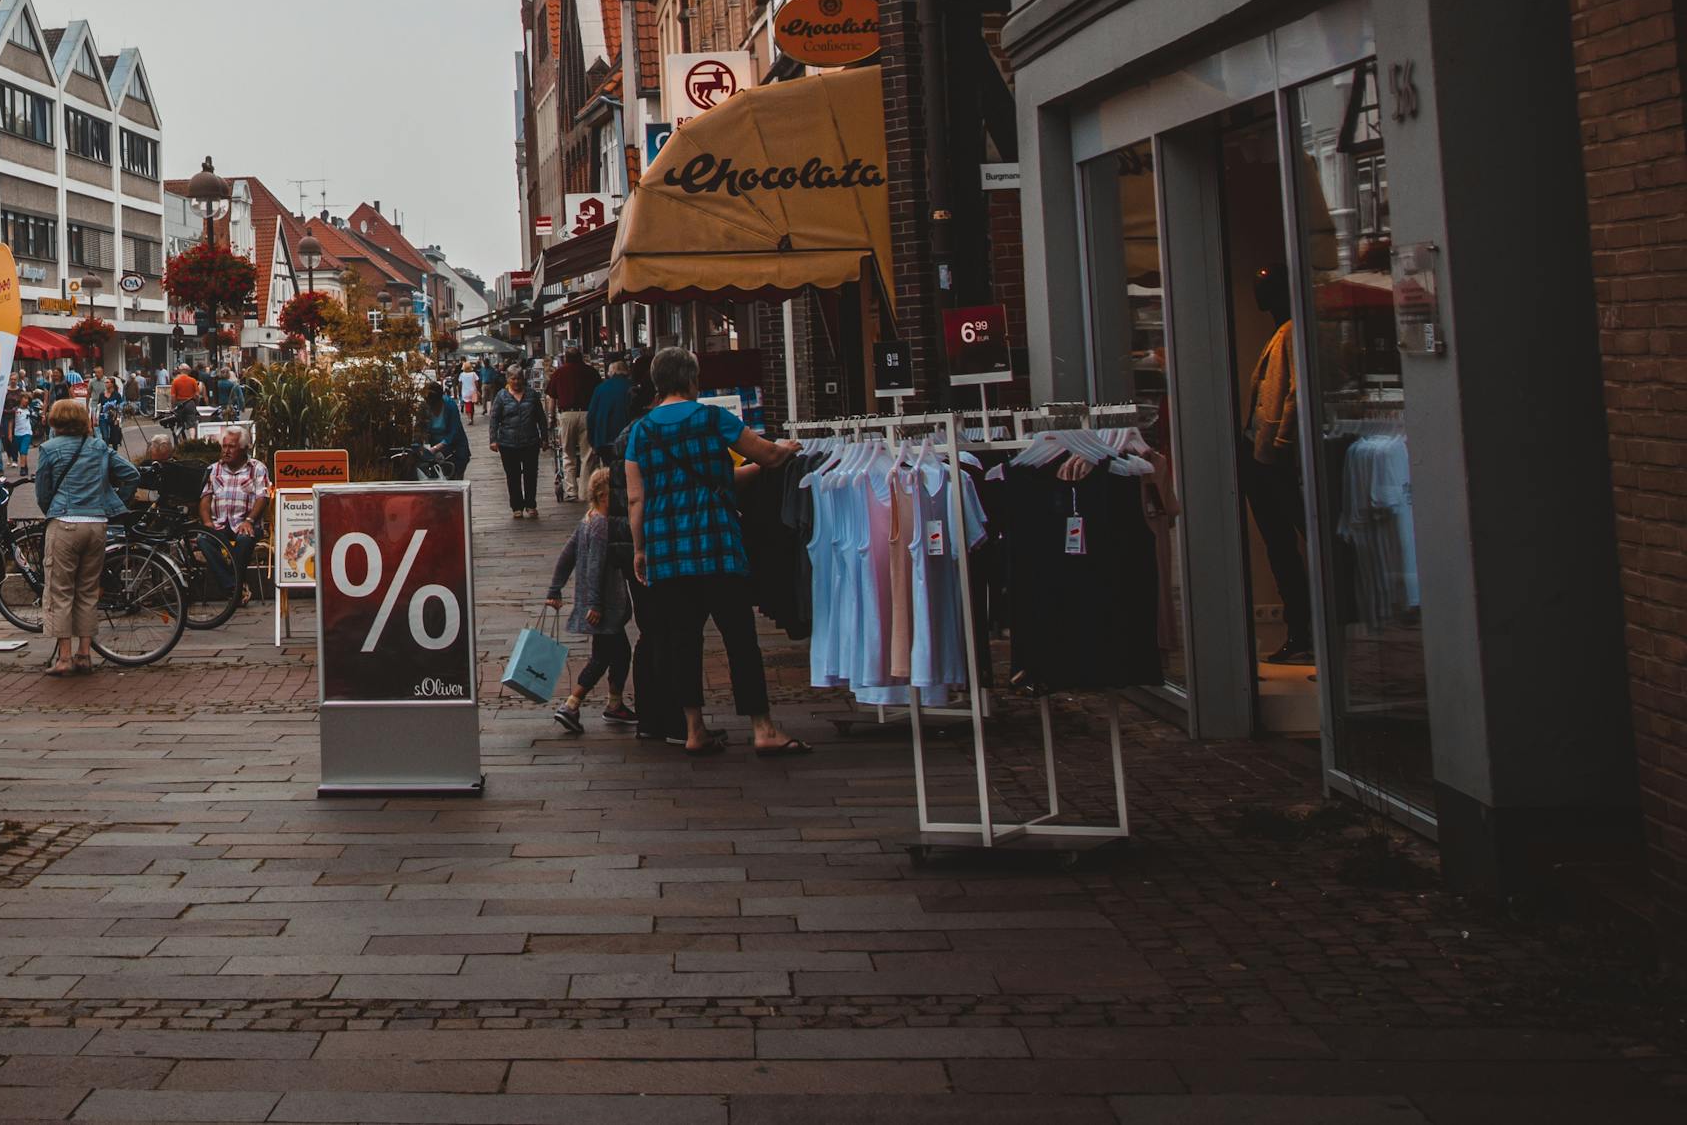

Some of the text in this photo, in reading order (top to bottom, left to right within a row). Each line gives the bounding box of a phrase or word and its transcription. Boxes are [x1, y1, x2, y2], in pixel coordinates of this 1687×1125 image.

[663, 152, 885, 196] Chocolata
[279, 463, 343, 477] Chocolata
[283, 502, 313, 510] Kaubo
[283, 571, 298, 579] 150
[330, 528, 461, 652] %
[414, 677, 463, 697] s.Oliver
